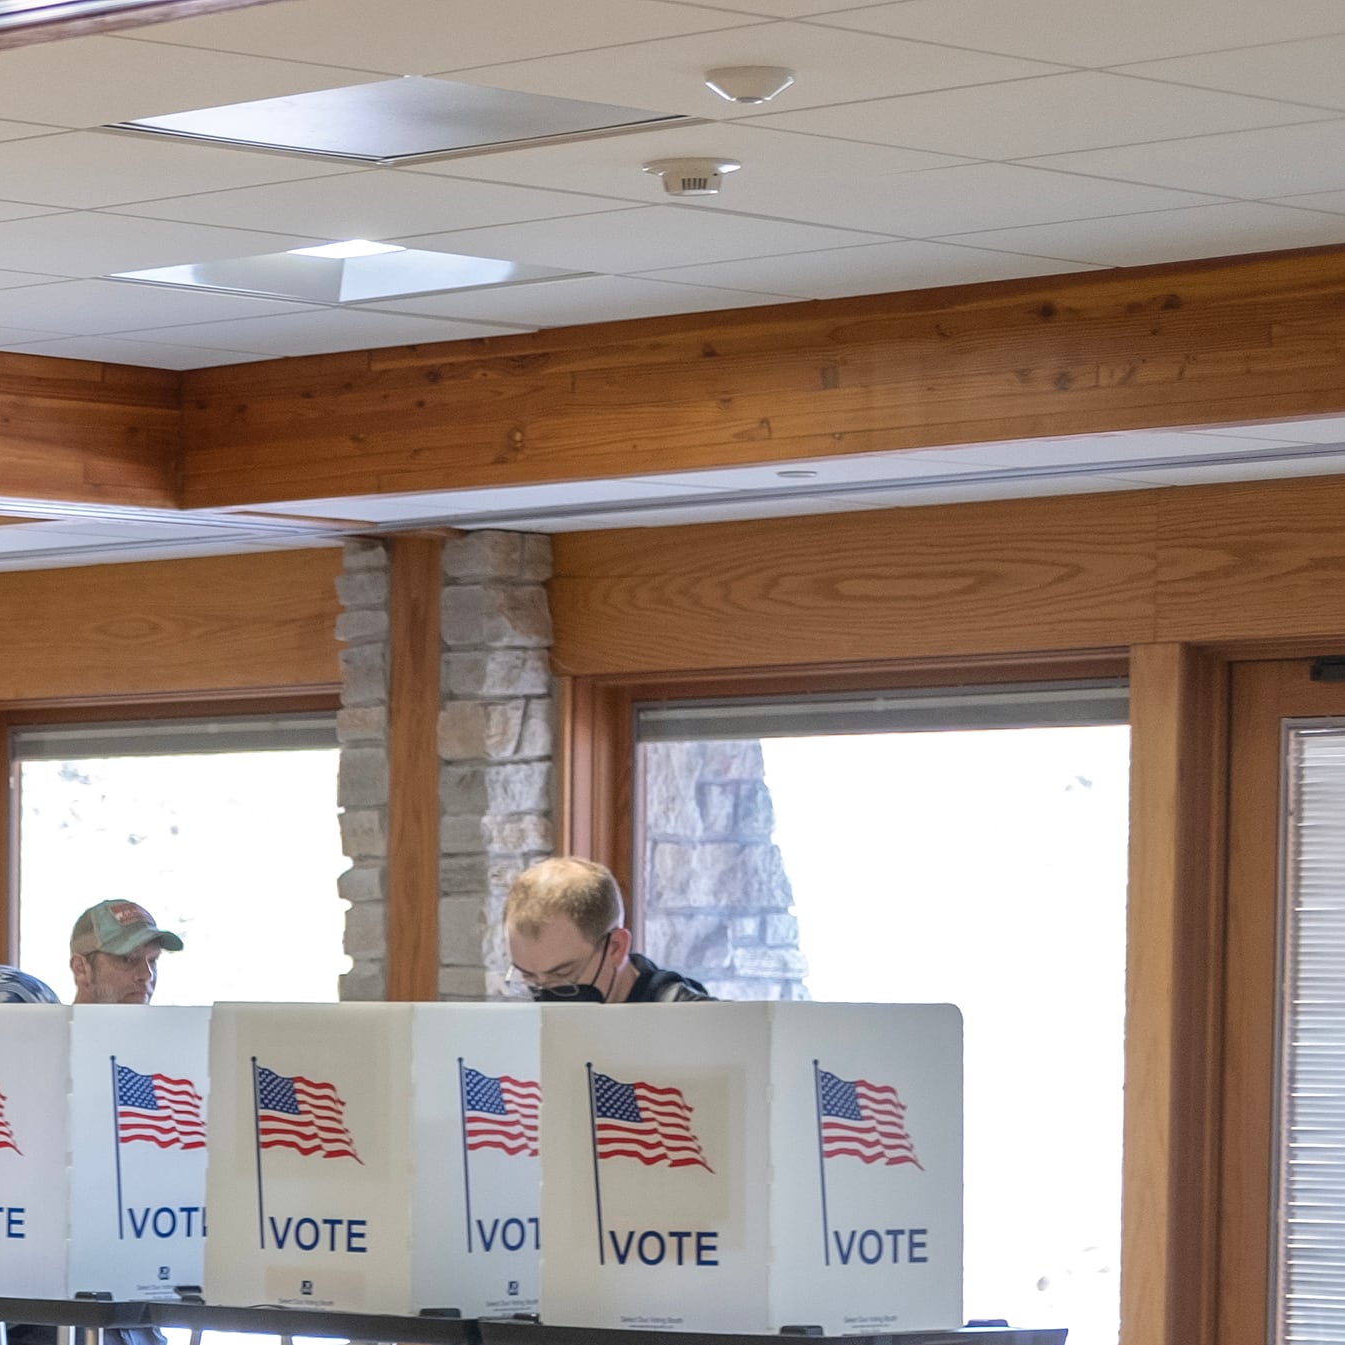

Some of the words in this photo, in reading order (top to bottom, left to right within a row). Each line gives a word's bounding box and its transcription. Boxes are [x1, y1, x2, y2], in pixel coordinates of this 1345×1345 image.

[128, 1207, 206, 1238] VOT
[269, 1217, 367, 1252] VOTE
[477, 1218, 540, 1252] VOT
[609, 1231, 718, 1266] VOTE
[833, 1229, 928, 1265] VOTE
